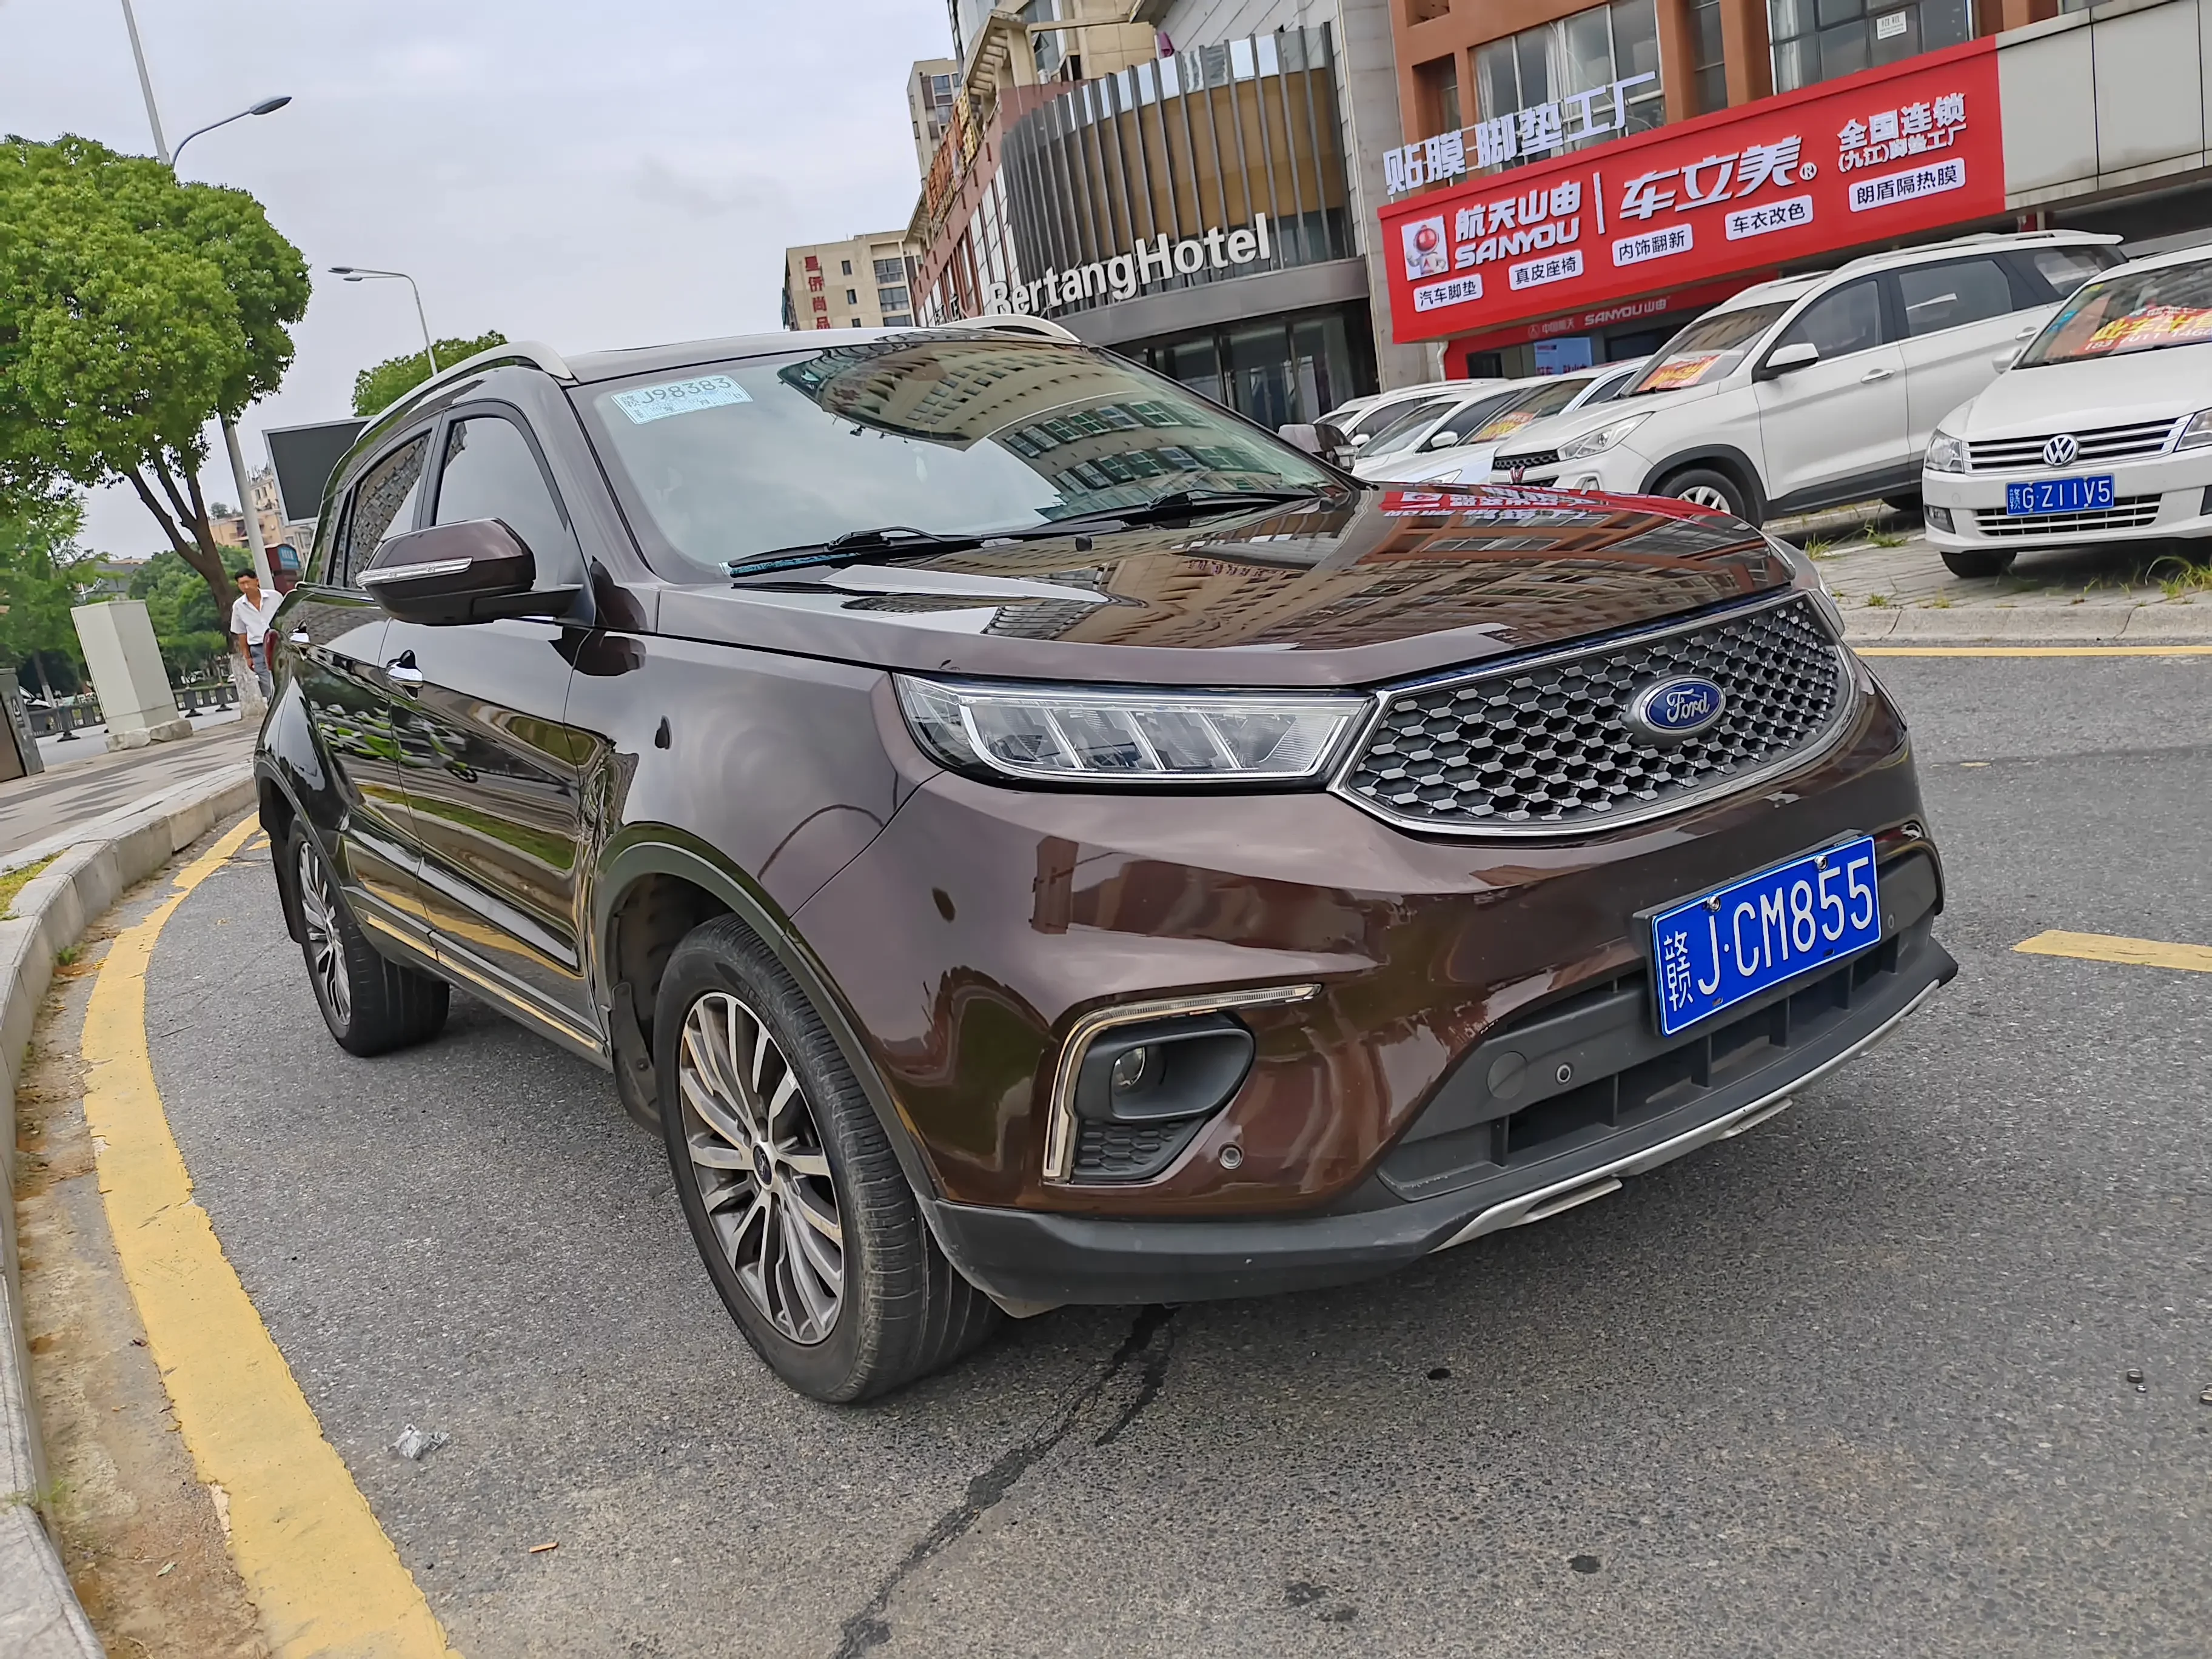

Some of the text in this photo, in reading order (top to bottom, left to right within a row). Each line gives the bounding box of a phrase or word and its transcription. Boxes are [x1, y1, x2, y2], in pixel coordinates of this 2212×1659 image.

[1837, 92, 1967, 152] 全国连锁
[1856, 164, 1958, 205] 朗盾隔热膜
[1732, 204, 1806, 235] 车衣改色
[1454, 216, 1580, 270] SANYOU
[1618, 230, 1685, 261] 内饰翻新
[1515, 256, 1577, 285] 真皮座椅
[1419, 278, 1477, 307] 汽车脚垫
[1666, 688, 1711, 723] Ford
